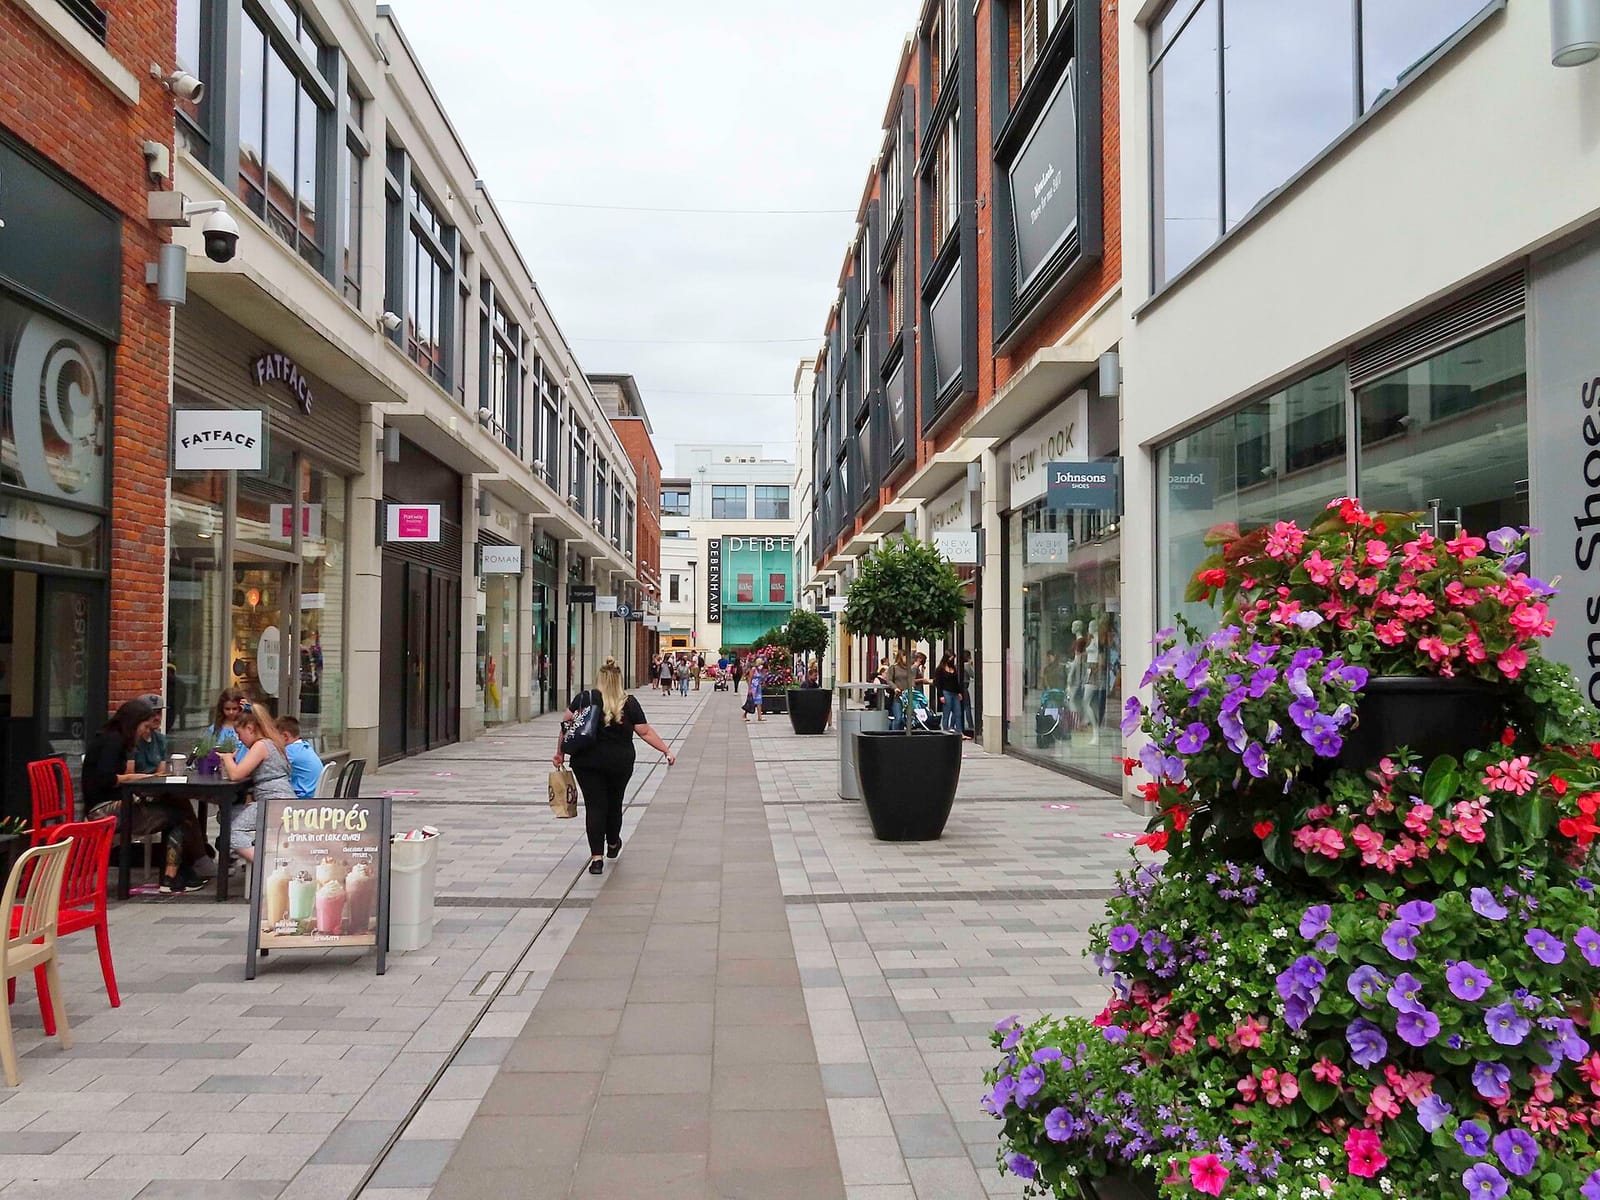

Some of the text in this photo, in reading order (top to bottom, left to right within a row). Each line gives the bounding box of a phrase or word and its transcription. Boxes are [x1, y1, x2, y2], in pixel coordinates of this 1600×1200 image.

[256, 354, 313, 415] FATFACE
[181, 430, 256, 448] FATFACE
[1011, 448, 1035, 485] NEW
[1055, 471, 1107, 485] Johnsons
[730, 536, 791, 552] DEBE
[941, 540, 969, 548] NEW
[485, 555, 519, 563] ROMAN
[710, 541, 719, 620] DEBENHAMS
[281, 803, 369, 833] frappés
[287, 832, 361, 842] drink in or take away
